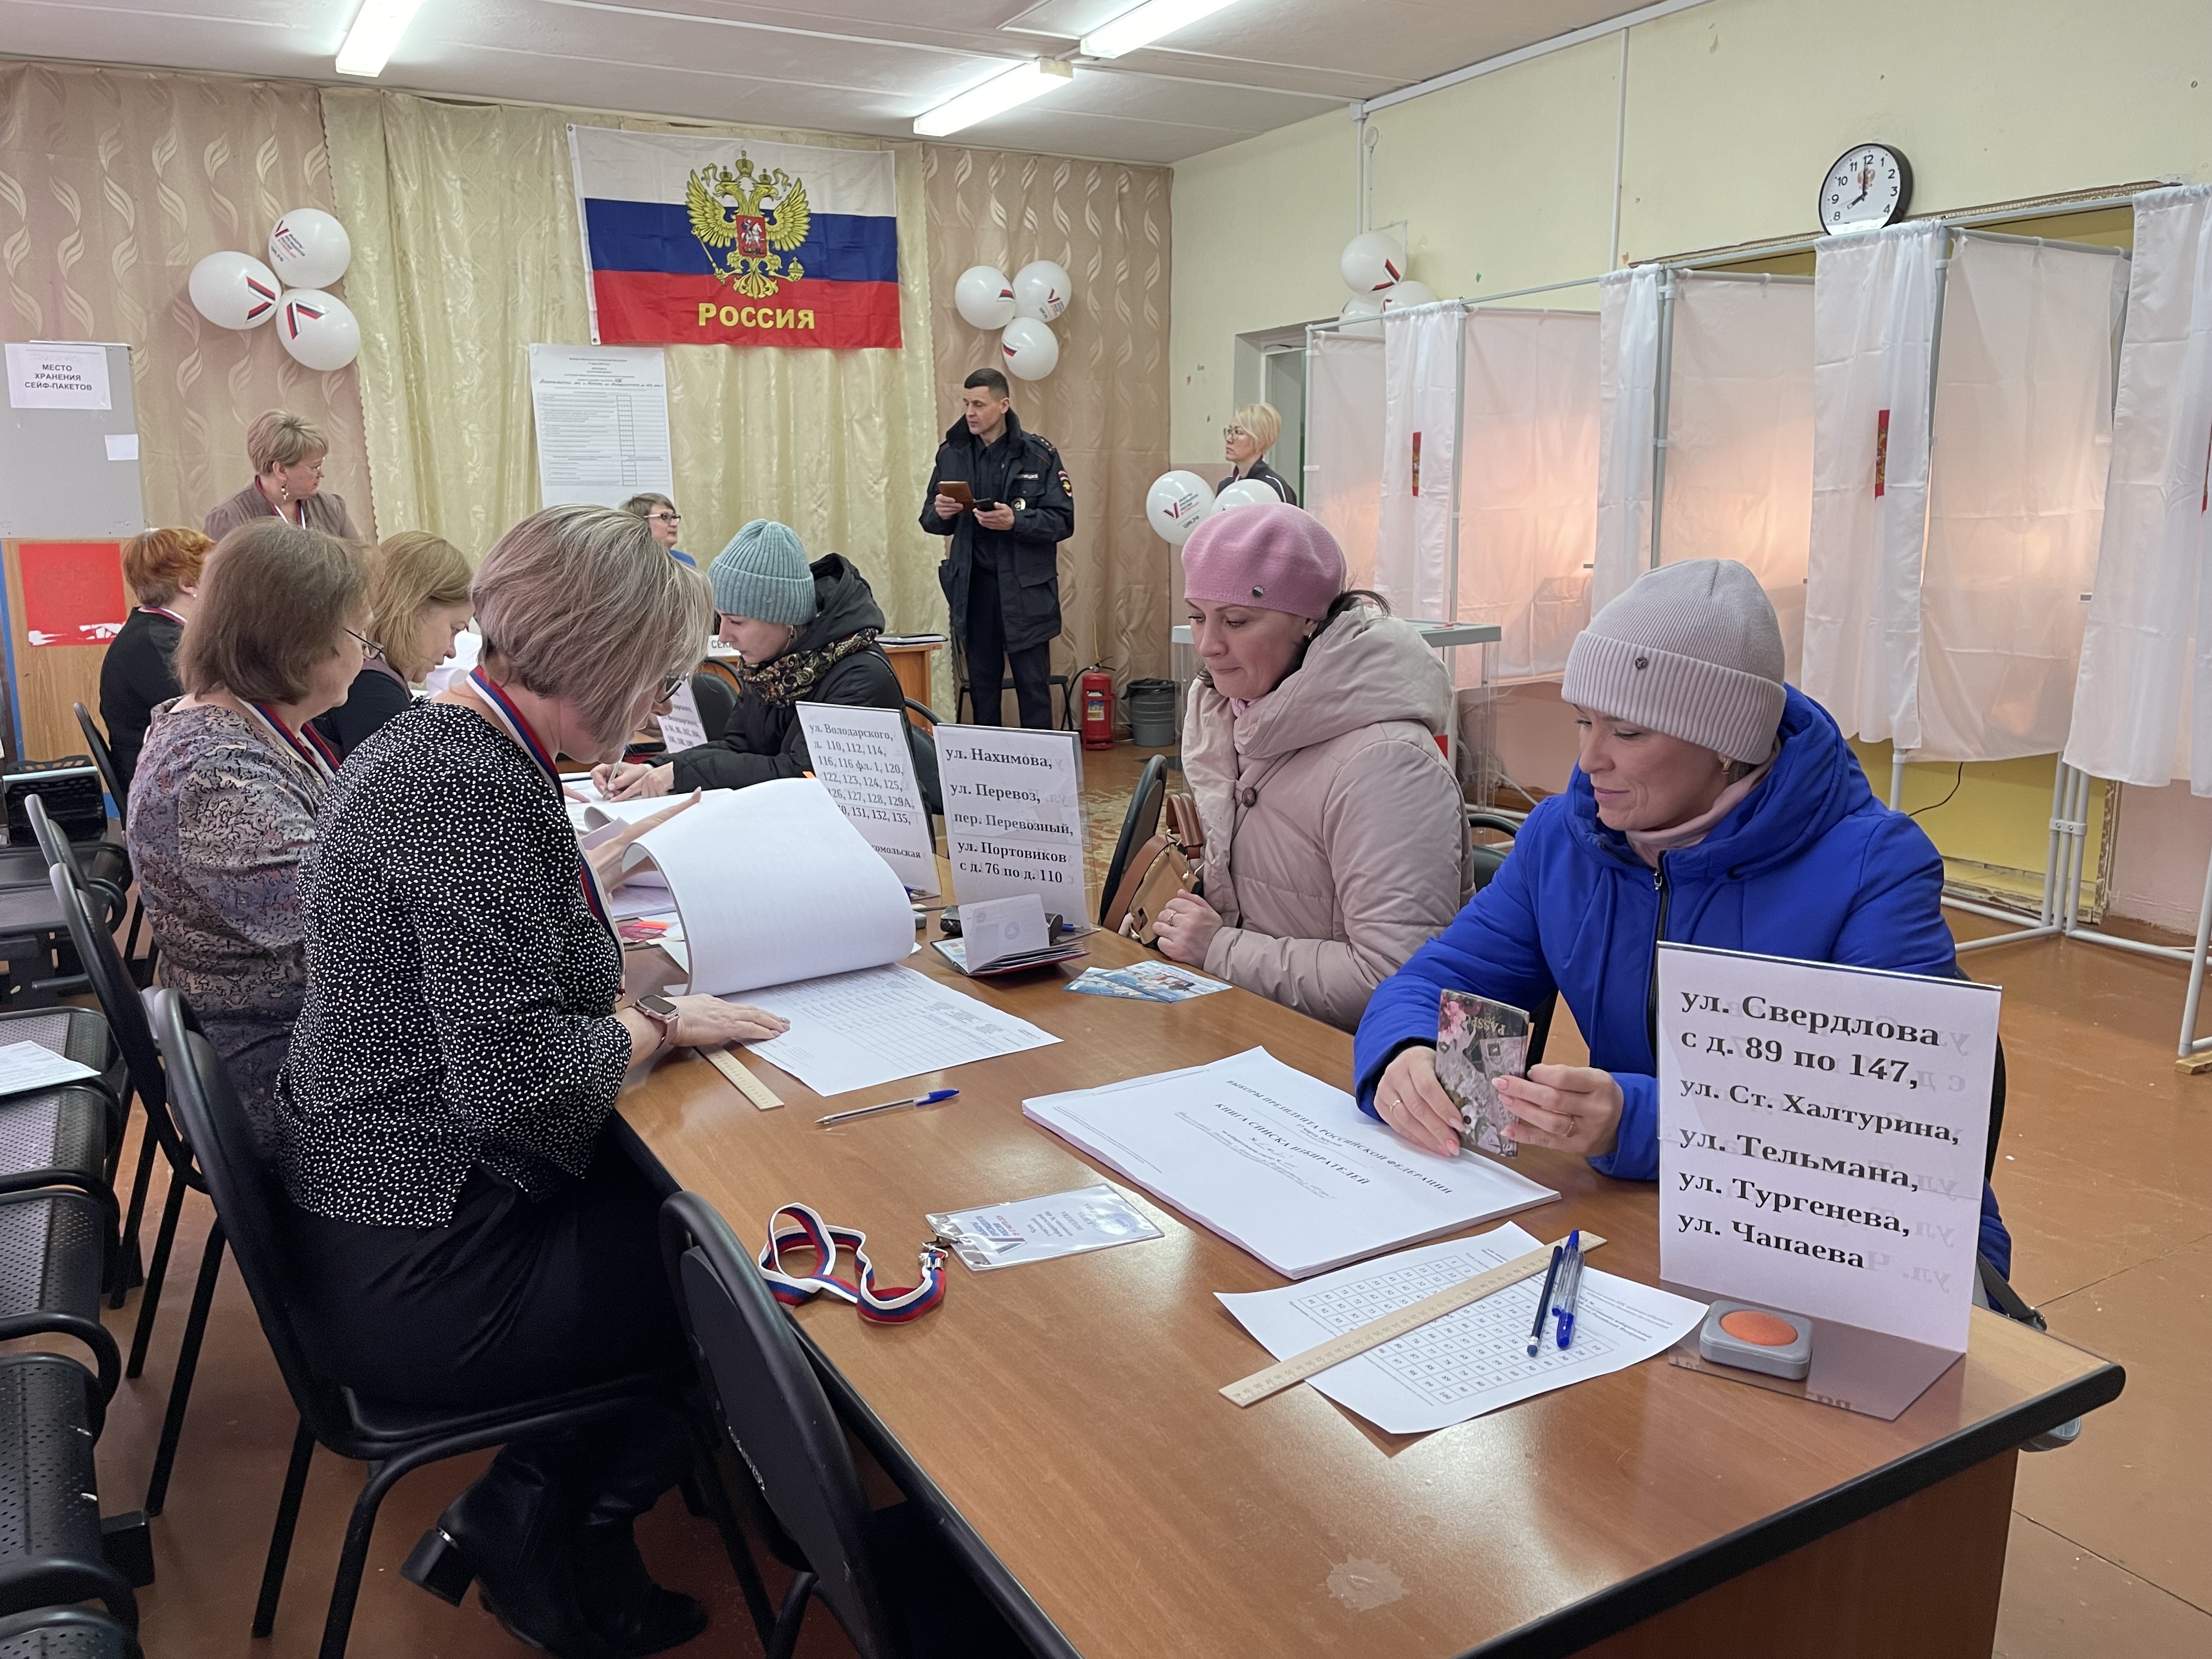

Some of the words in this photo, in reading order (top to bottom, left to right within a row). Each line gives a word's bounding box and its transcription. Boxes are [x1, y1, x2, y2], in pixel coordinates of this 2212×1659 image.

[1849, 162, 1858, 172] 11
[1863, 154, 1874, 165] 12
[1881, 157, 1884, 167] 1
[1837, 176, 1848, 187] 10
[1888, 169, 1895, 179] 2
[1831, 194, 1839, 204] 9
[1890, 186, 1898, 196] 3
[1833, 211, 1841, 221] 8
[1883, 204, 1891, 214] 4
[698, 302, 815, 329] РОССИЯ
[25, 381, 92, 391] СЕЙФ-ПАКЕТОВ
[809, 725, 823, 733] ул.
[823, 724, 893, 741] Володарского,
[814, 741, 822, 749] д.
[826, 741, 845, 753] 110,
[846, 742, 865, 755] 112,
[867, 745, 886, 757] 114,
[945, 748, 967, 761] ул.
[970, 748, 1052, 769] Нахимова,
[818, 755, 837, 768] 116,
[838, 758, 854, 769] 116
[856, 760, 872, 772] фл.
[874, 762, 883, 774] 1,
[884, 763, 904, 776] 120,
[823, 772, 841, 784] 122,
[843, 774, 861, 786] 123,
[863, 776, 882, 789] 124,
[883, 779, 903, 792] 125,
[848, 791, 866, 803] 127,
[867, 793, 886, 806] 128,
[888, 796, 915, 810] 129А,
[950, 783, 972, 795] ул.
[975, 783, 1040, 803] Перевоз,
[852, 806, 870, 820] 131,
[872, 810, 890, 822] 132,
[892, 812, 911, 825] 135,
[953, 814, 982, 827] пер.
[985, 815, 1074, 836] Перевозный,
[957, 842, 978, 853] ул.
[980, 842, 1066, 862] Портовиков
[960, 862, 967, 871] с
[970, 864, 982, 873] д.
[985, 862, 1000, 874] 76
[1003, 868, 1020, 878] по
[1024, 870, 1036, 881] д.
[1040, 870, 1062, 883] 110
[1680, 991, 1729, 1014] ул.
[1742, 995, 1940, 1046] Свердлова
[1680, 1031, 1697, 1048] с
[1706, 1036, 1733, 1056] д.
[1745, 1037, 1782, 1062] 89
[1793, 1051, 1835, 1072] по
[1849, 1053, 1918, 1089] 147,
[1680, 1079, 1719, 1099] ул.
[1729, 1085, 1773, 1109] Ст.
[1782, 1093, 1960, 1146] Халтурина,
[1215, 1103, 1248, 1122] КНИГА
[1249, 1121, 1290, 1147] СПИСКА
[1290, 1146, 1370, 1184] ИЗБИРАТЕЛЕЙ
[1226, 1080, 1263, 1098] ВЫБОРЫ
[1262, 1097, 1319, 1129] ПРЕЗИДЕНТА
[1319, 1128, 1388, 1160] РОССИЙСКОЙ
[1387, 1160, 1453, 1194] ФЕДЕРАЦИИ
[1679, 1128, 1726, 1152] ул.
[1736, 1135, 1918, 1192] Тельмана,
[1679, 1171, 1722, 1194] ул.
[1732, 1178, 1910, 1237] Тургенева,
[1678, 1214, 1721, 1235] ул.
[1731, 1220, 1864, 1268] Чапаева
